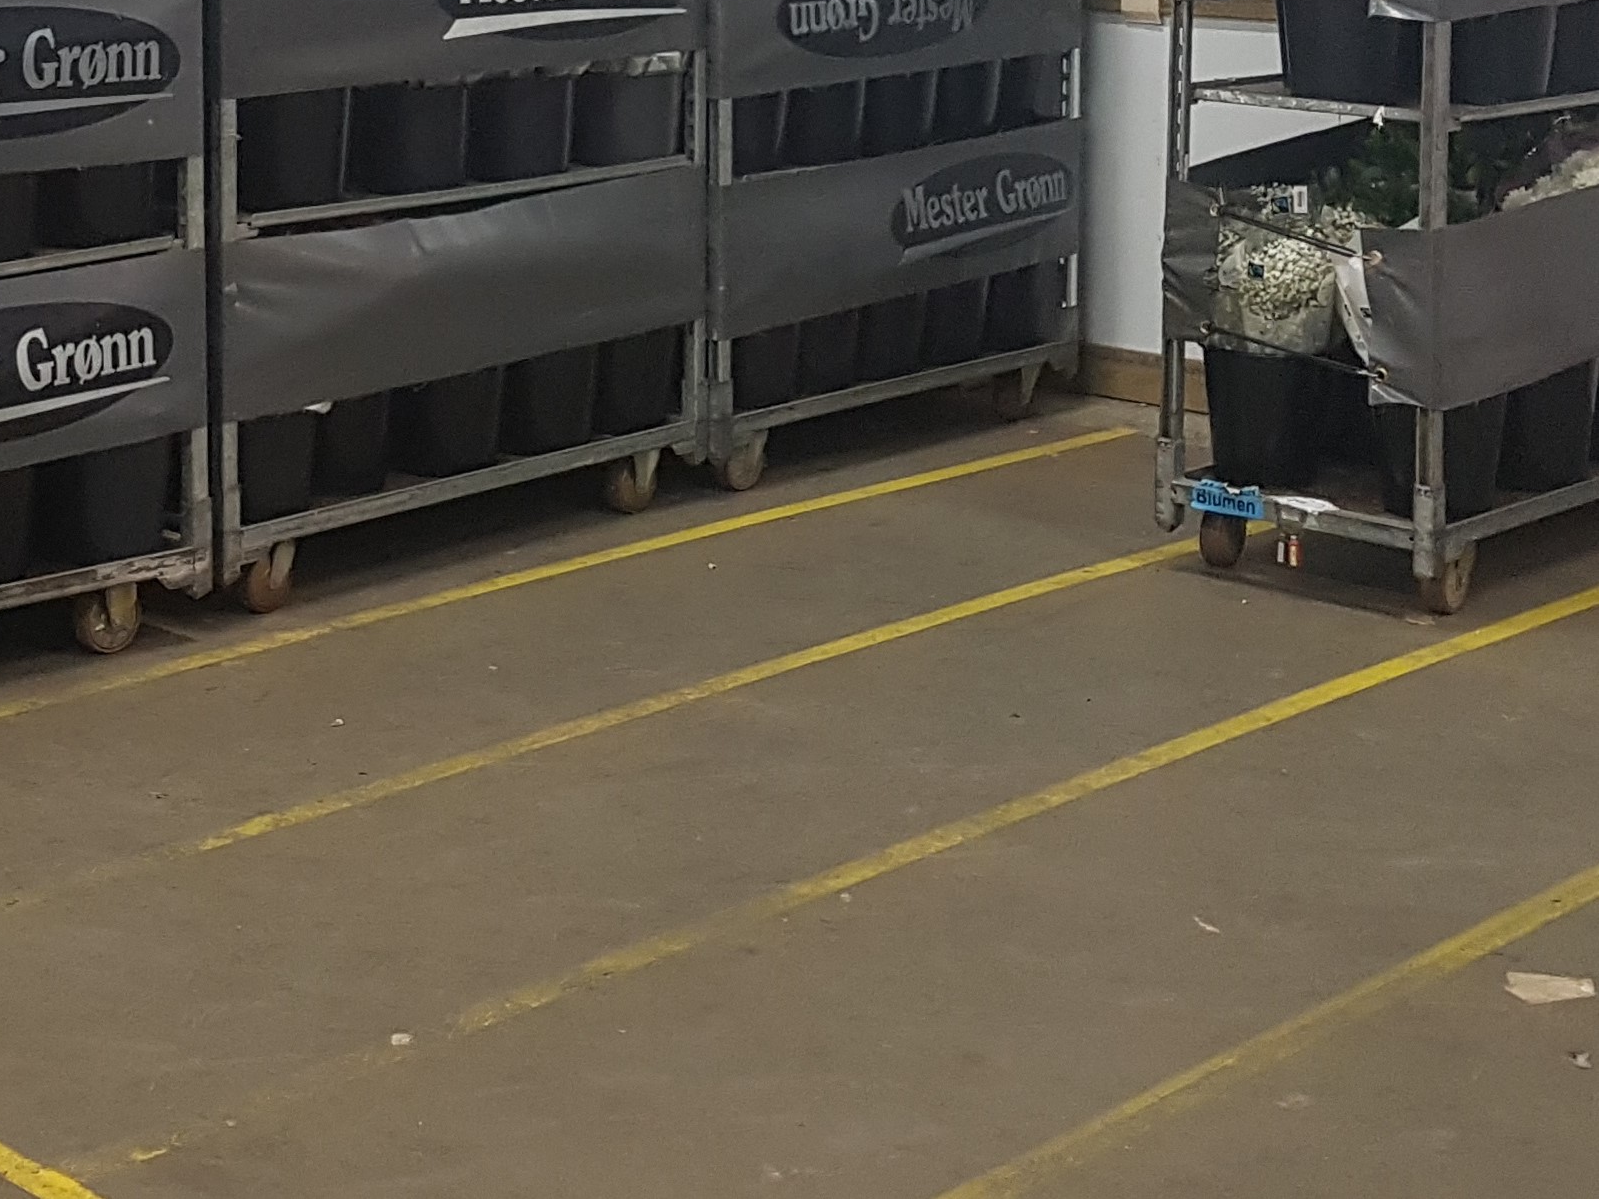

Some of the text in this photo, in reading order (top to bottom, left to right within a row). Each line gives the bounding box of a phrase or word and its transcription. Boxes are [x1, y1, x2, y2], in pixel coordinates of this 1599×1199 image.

[22, 28, 162, 90] Grønn
[902, 183, 988, 233] Mester
[16, 326, 156, 391] Grønn
[1196, 488, 1256, 514] Blumen
